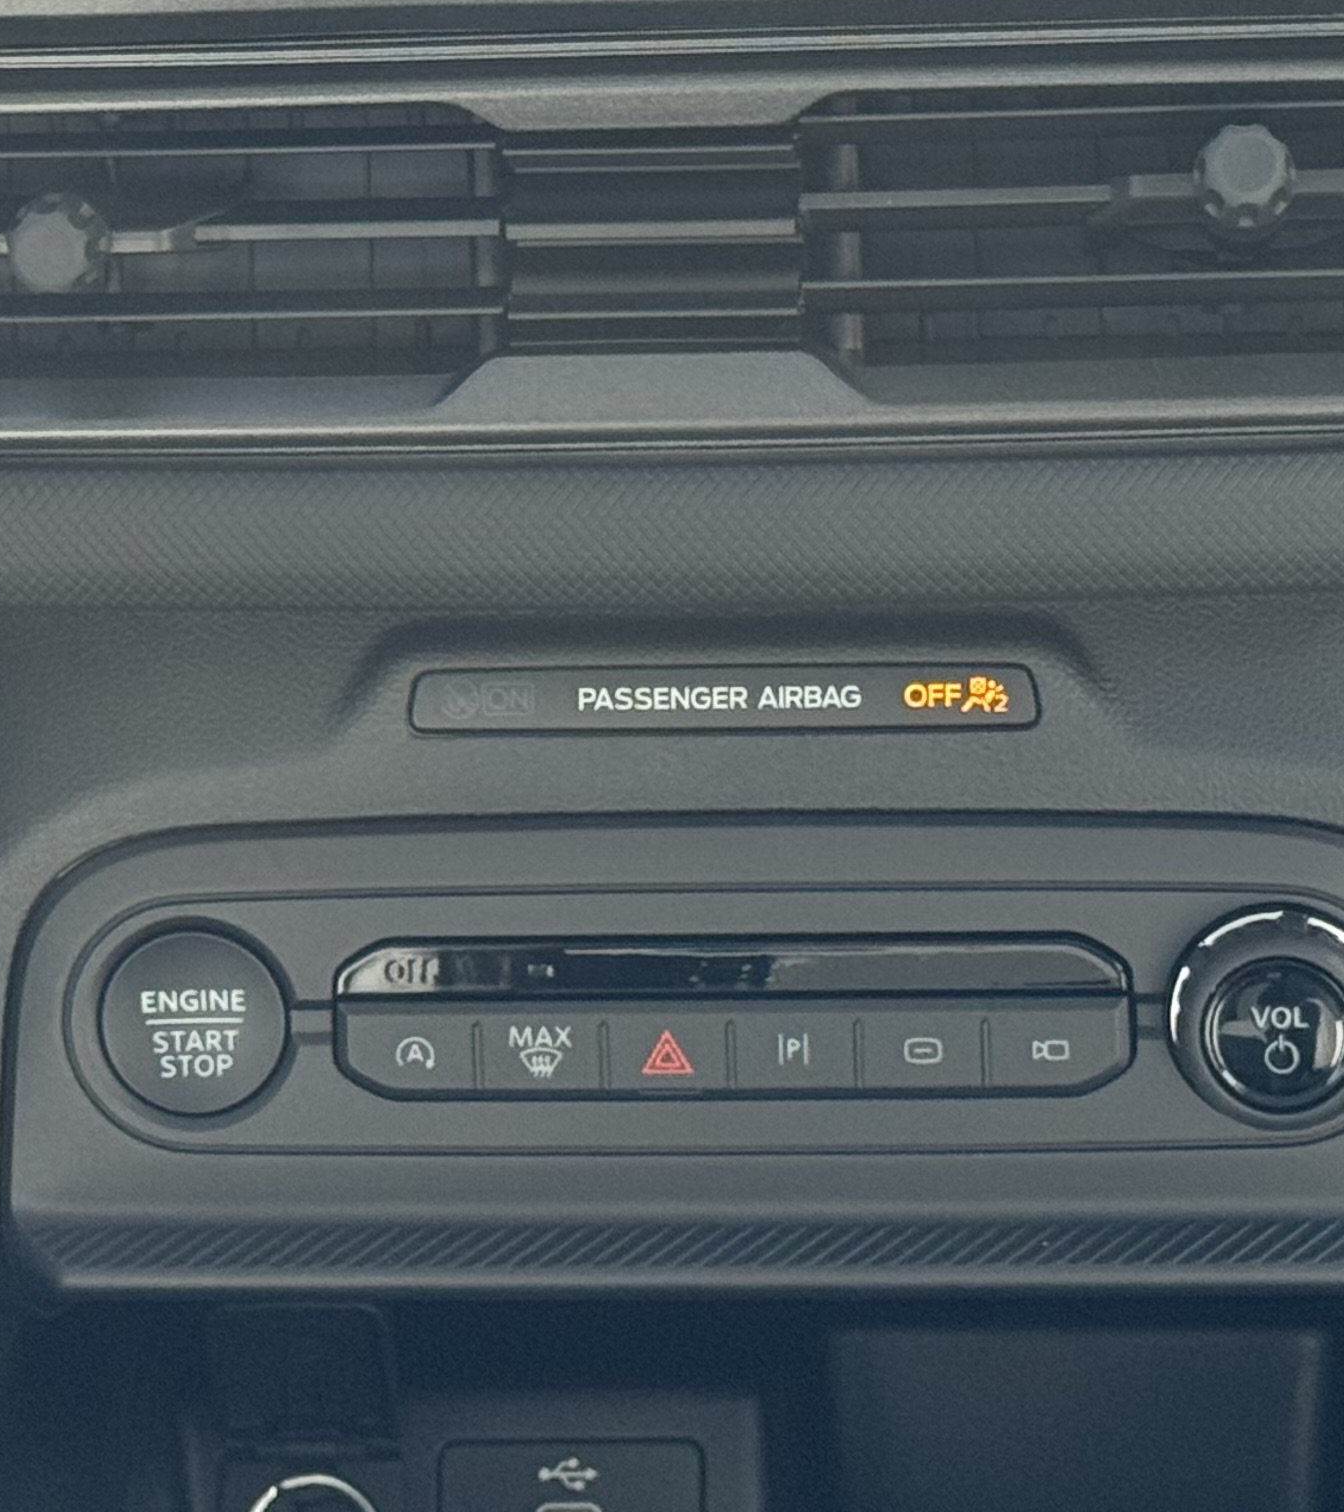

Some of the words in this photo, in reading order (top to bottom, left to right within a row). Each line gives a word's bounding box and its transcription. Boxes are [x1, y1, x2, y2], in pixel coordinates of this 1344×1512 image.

[578, 686, 748, 711] PASSENGER
[757, 685, 862, 710] AIRBAG
[903, 683, 961, 708] OFF
[140, 989, 246, 1014] ENGINE
[1250, 1006, 1309, 1029] VOL
[152, 1029, 239, 1054] START
[508, 1025, 572, 1048] MAX
[160, 1053, 234, 1078] STOP
